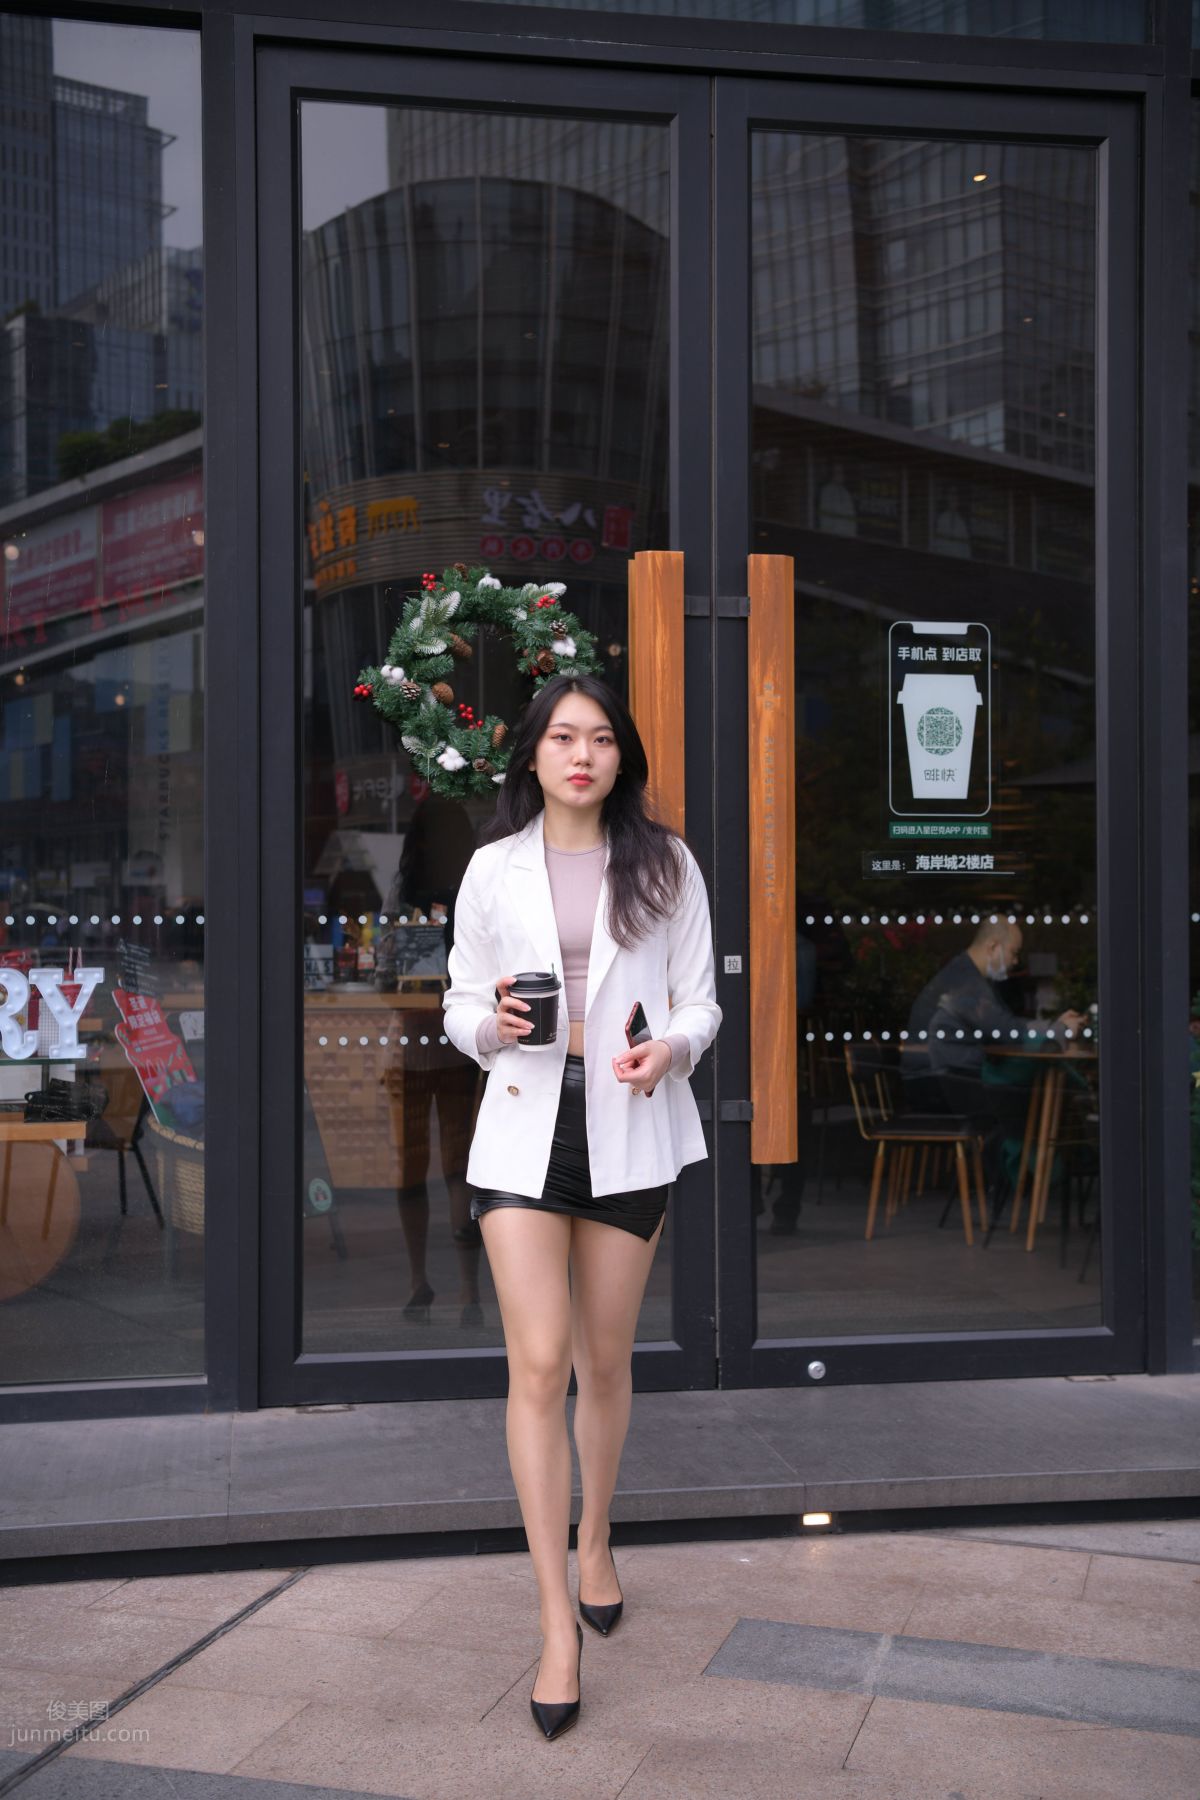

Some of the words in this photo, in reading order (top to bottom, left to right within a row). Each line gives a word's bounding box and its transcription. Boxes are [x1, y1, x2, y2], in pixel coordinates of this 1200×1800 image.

[897, 646, 938, 661] 手机点
[941, 647, 982, 662] 到店取
[156, 642, 171, 718] RESERV
[923, 768, 956, 782] 啡快
[915, 855, 995, 870] 海岸城2楼店
[727, 957, 740, 971] 拉
